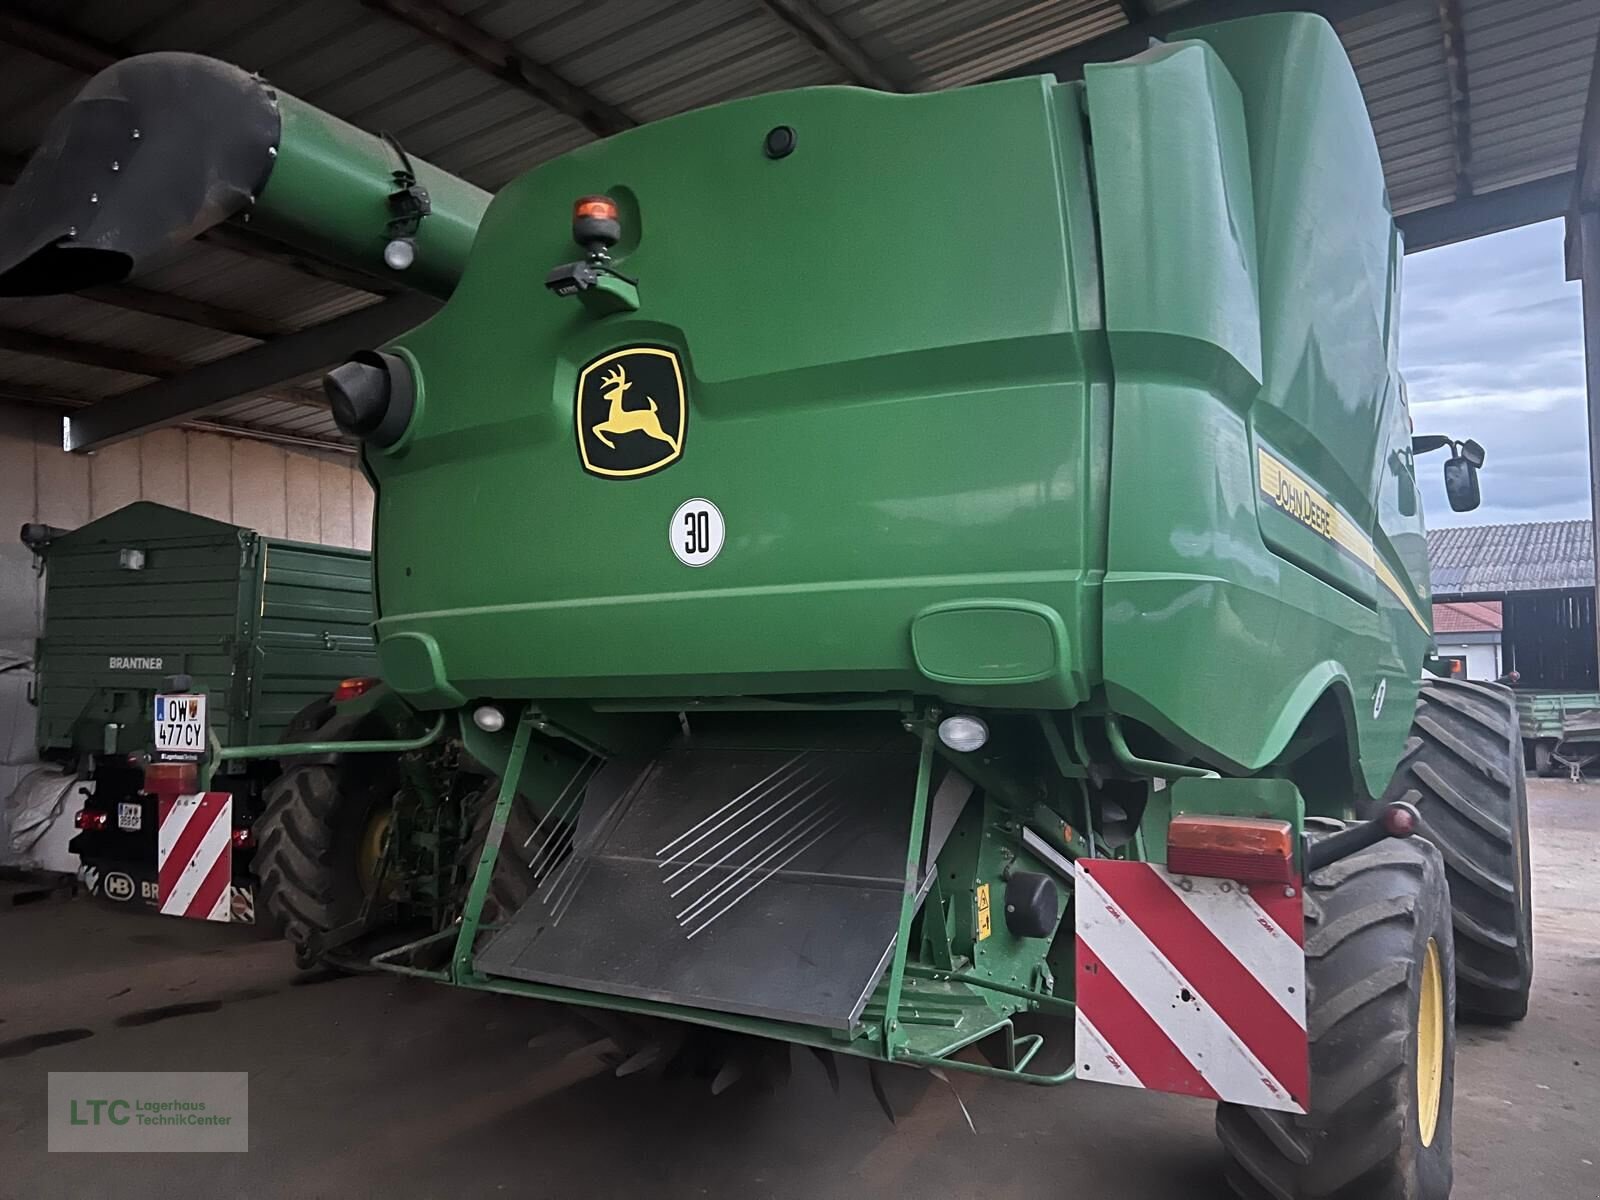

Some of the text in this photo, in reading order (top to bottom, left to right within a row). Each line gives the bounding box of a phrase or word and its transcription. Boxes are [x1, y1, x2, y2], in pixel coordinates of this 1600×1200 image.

[684, 511, 710, 554] 30
[109, 657, 163, 670] BRANTNER
[169, 700, 188, 722] OW
